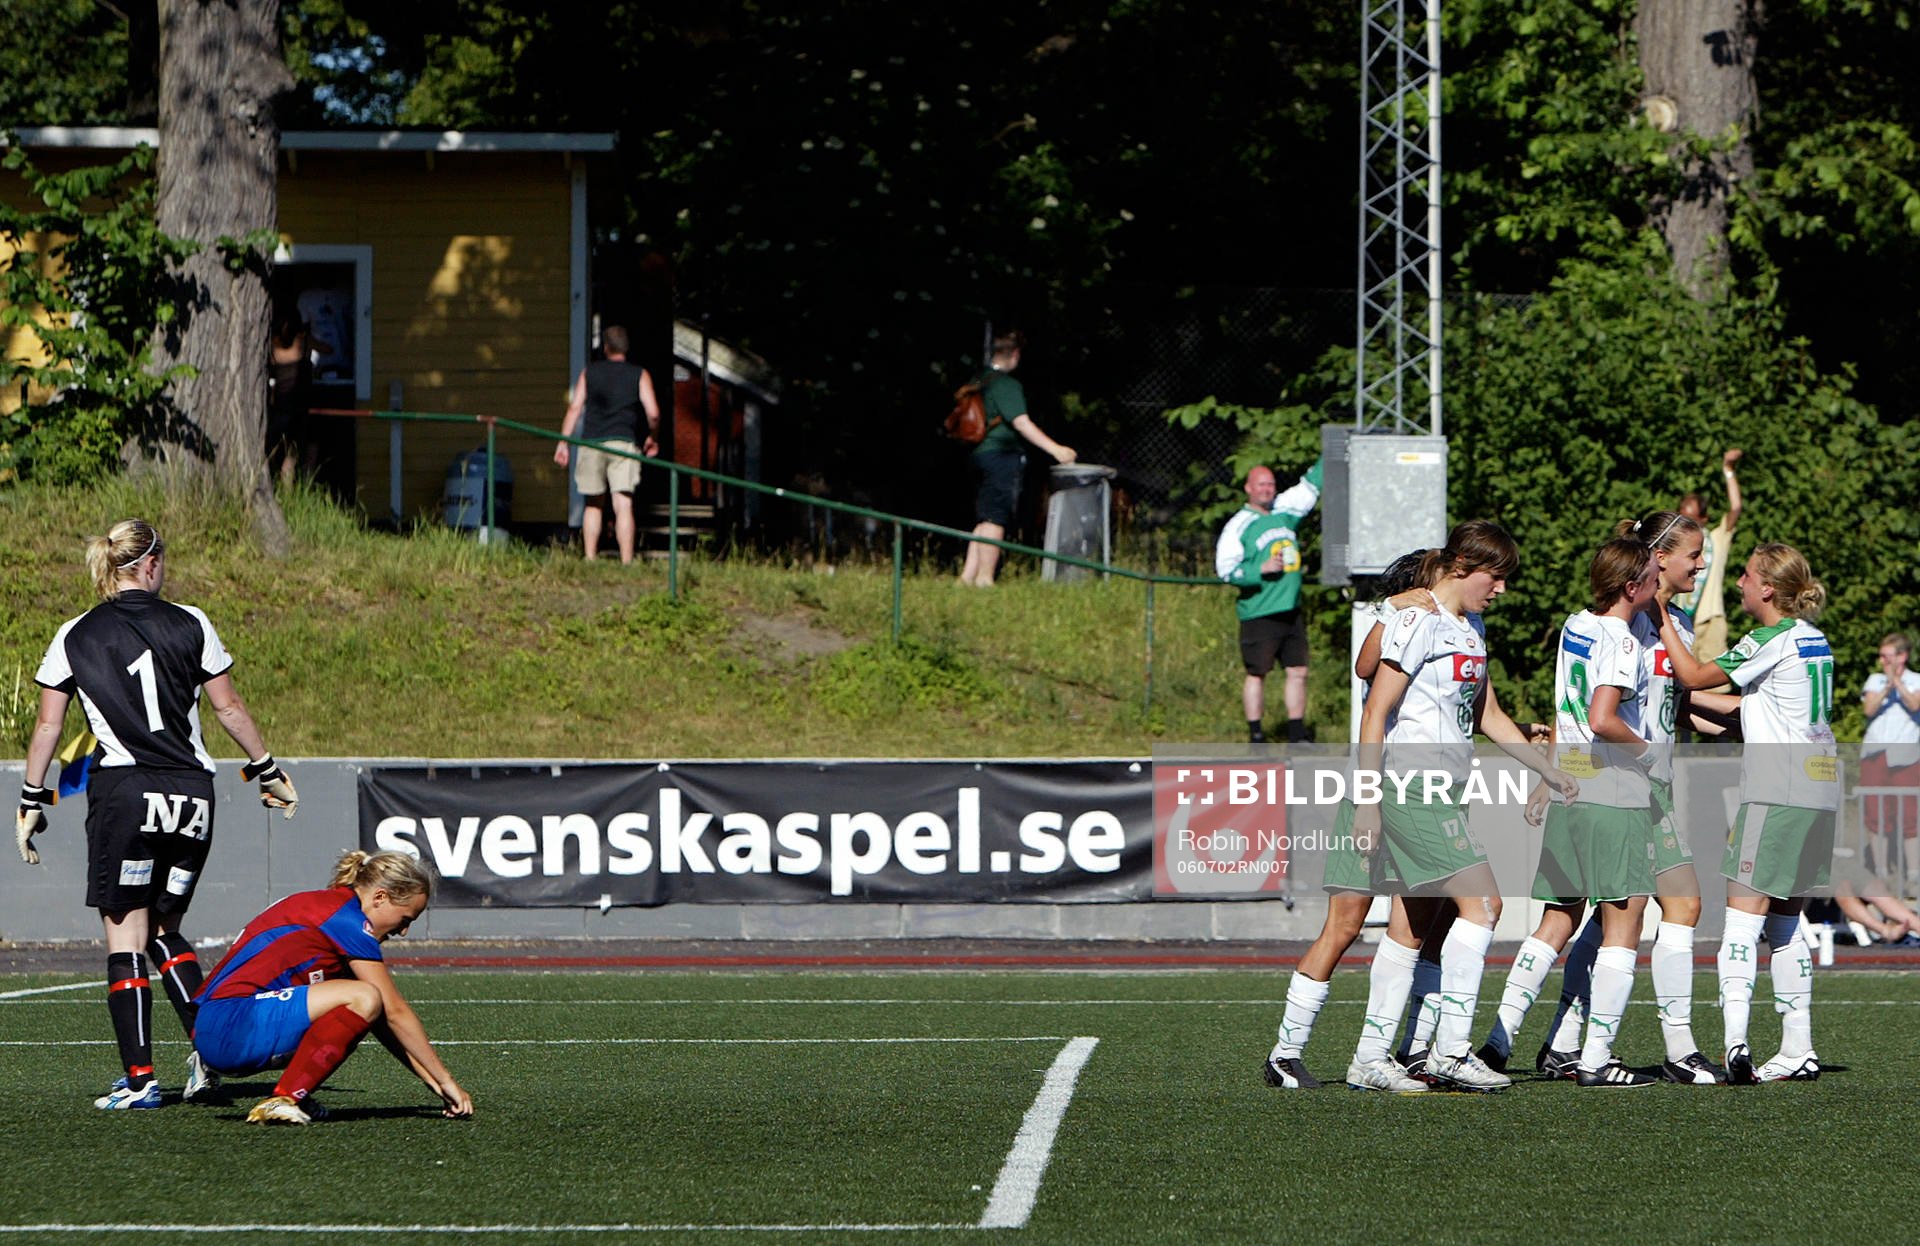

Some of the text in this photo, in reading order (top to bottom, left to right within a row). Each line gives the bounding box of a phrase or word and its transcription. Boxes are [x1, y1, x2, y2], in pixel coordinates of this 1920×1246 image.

[126, 649, 165, 733] 1
[1807, 661, 1834, 726] 10
[140, 792, 210, 841] NA
[376, 787, 1126, 896] svenskaspel.se
[1518, 952, 1535, 972] H
[1729, 943, 1748, 962] H
